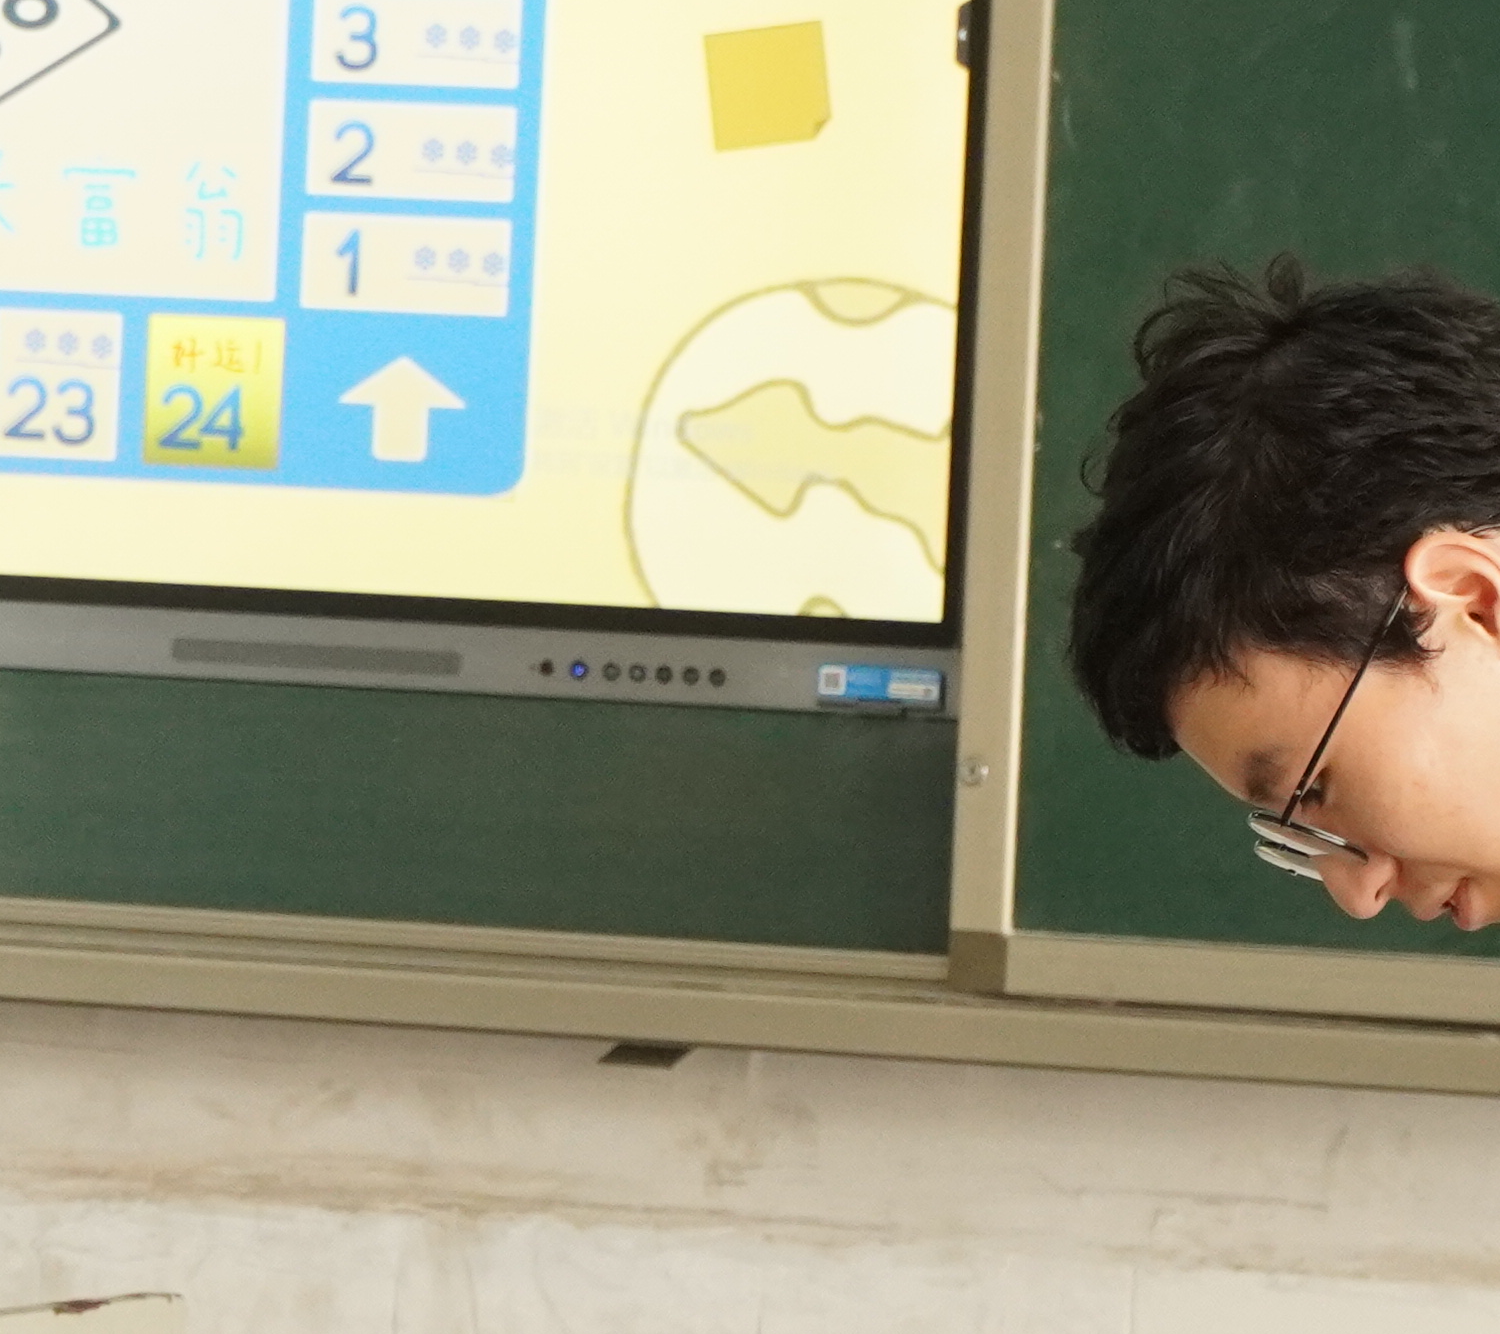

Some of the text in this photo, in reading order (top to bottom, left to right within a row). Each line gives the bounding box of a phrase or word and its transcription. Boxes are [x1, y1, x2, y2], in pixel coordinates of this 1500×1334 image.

[336, 5, 378, 71] 3
[331, 121, 375, 185] 2
[337, 230, 360, 295] 1
[4, 377, 95, 445] 23
[157, 385, 244, 452] 24
